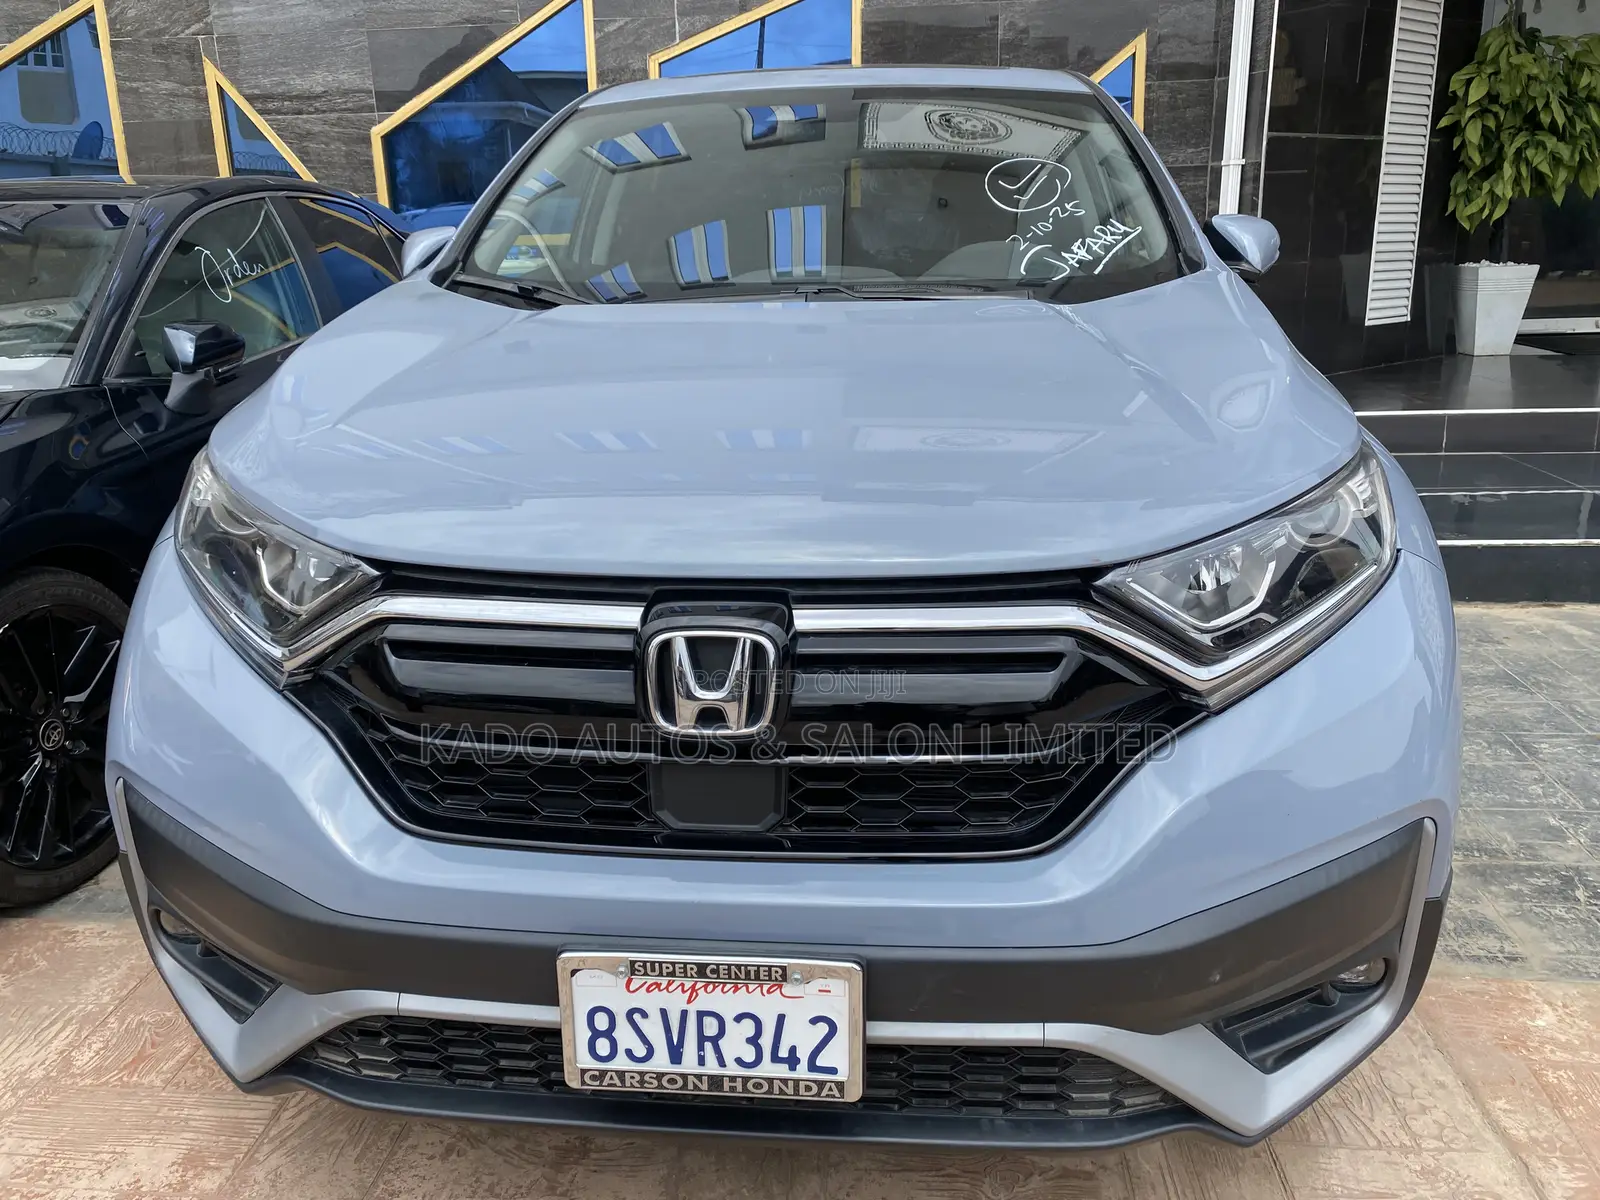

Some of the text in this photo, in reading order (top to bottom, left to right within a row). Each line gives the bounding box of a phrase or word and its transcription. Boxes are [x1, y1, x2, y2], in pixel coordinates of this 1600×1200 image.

[634, 961, 783, 981] SUPER CENTER
[586, 1004, 839, 1076] 8SVR342
[583, 1070, 841, 1099] CARSON HONDA
